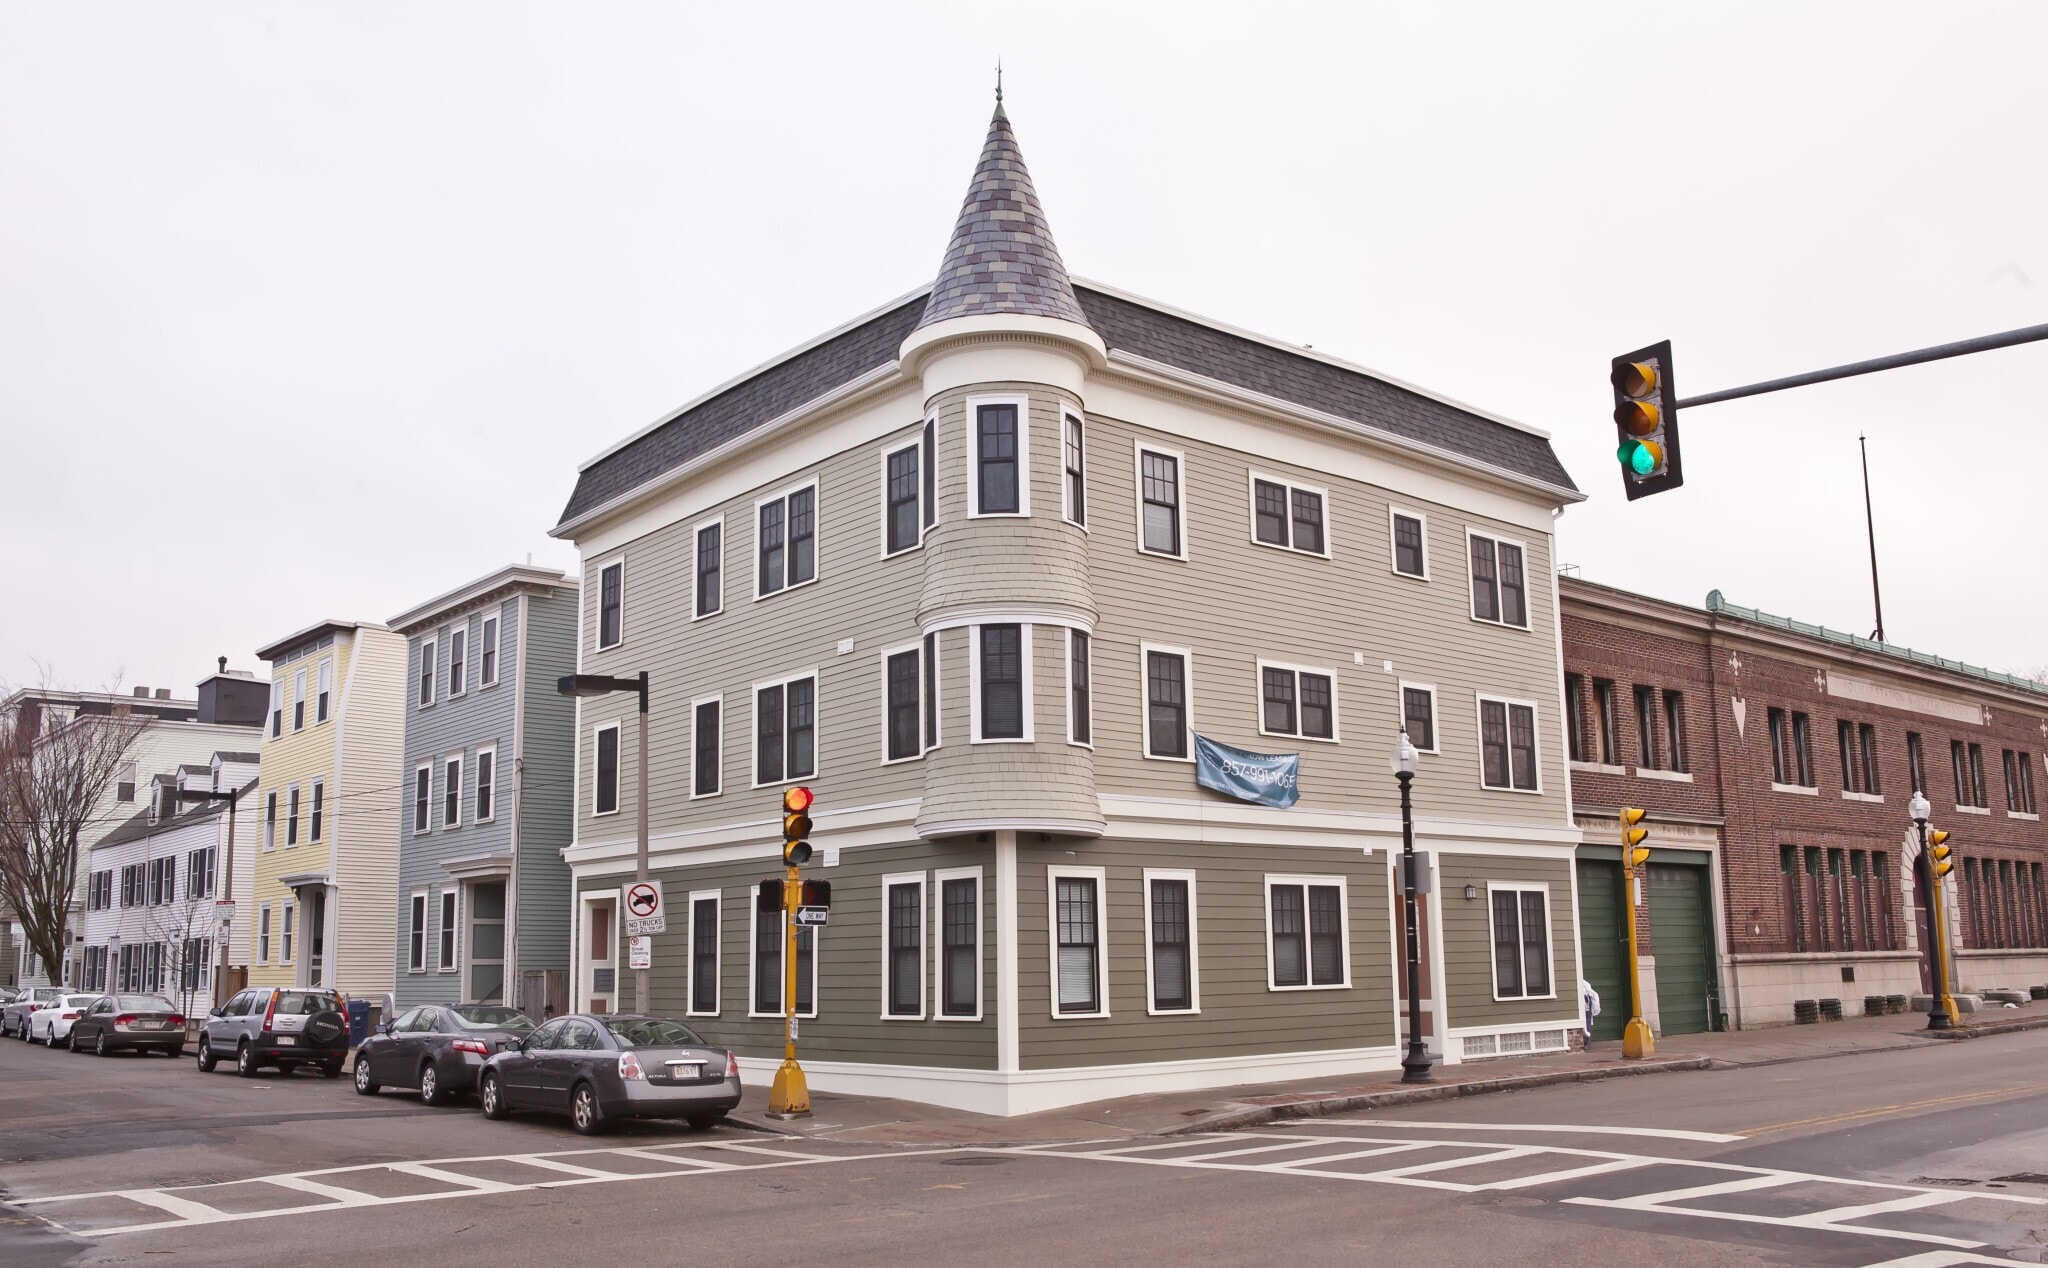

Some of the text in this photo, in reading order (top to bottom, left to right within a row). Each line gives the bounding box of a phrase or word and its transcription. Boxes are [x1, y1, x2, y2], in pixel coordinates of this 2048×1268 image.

[1221, 759, 1296, 789] 857-991-1065
[805, 912, 824, 920] ONE WAY
[628, 918, 663, 929] NO TRUCKS
[316, 1021, 339, 1030] HONDA
